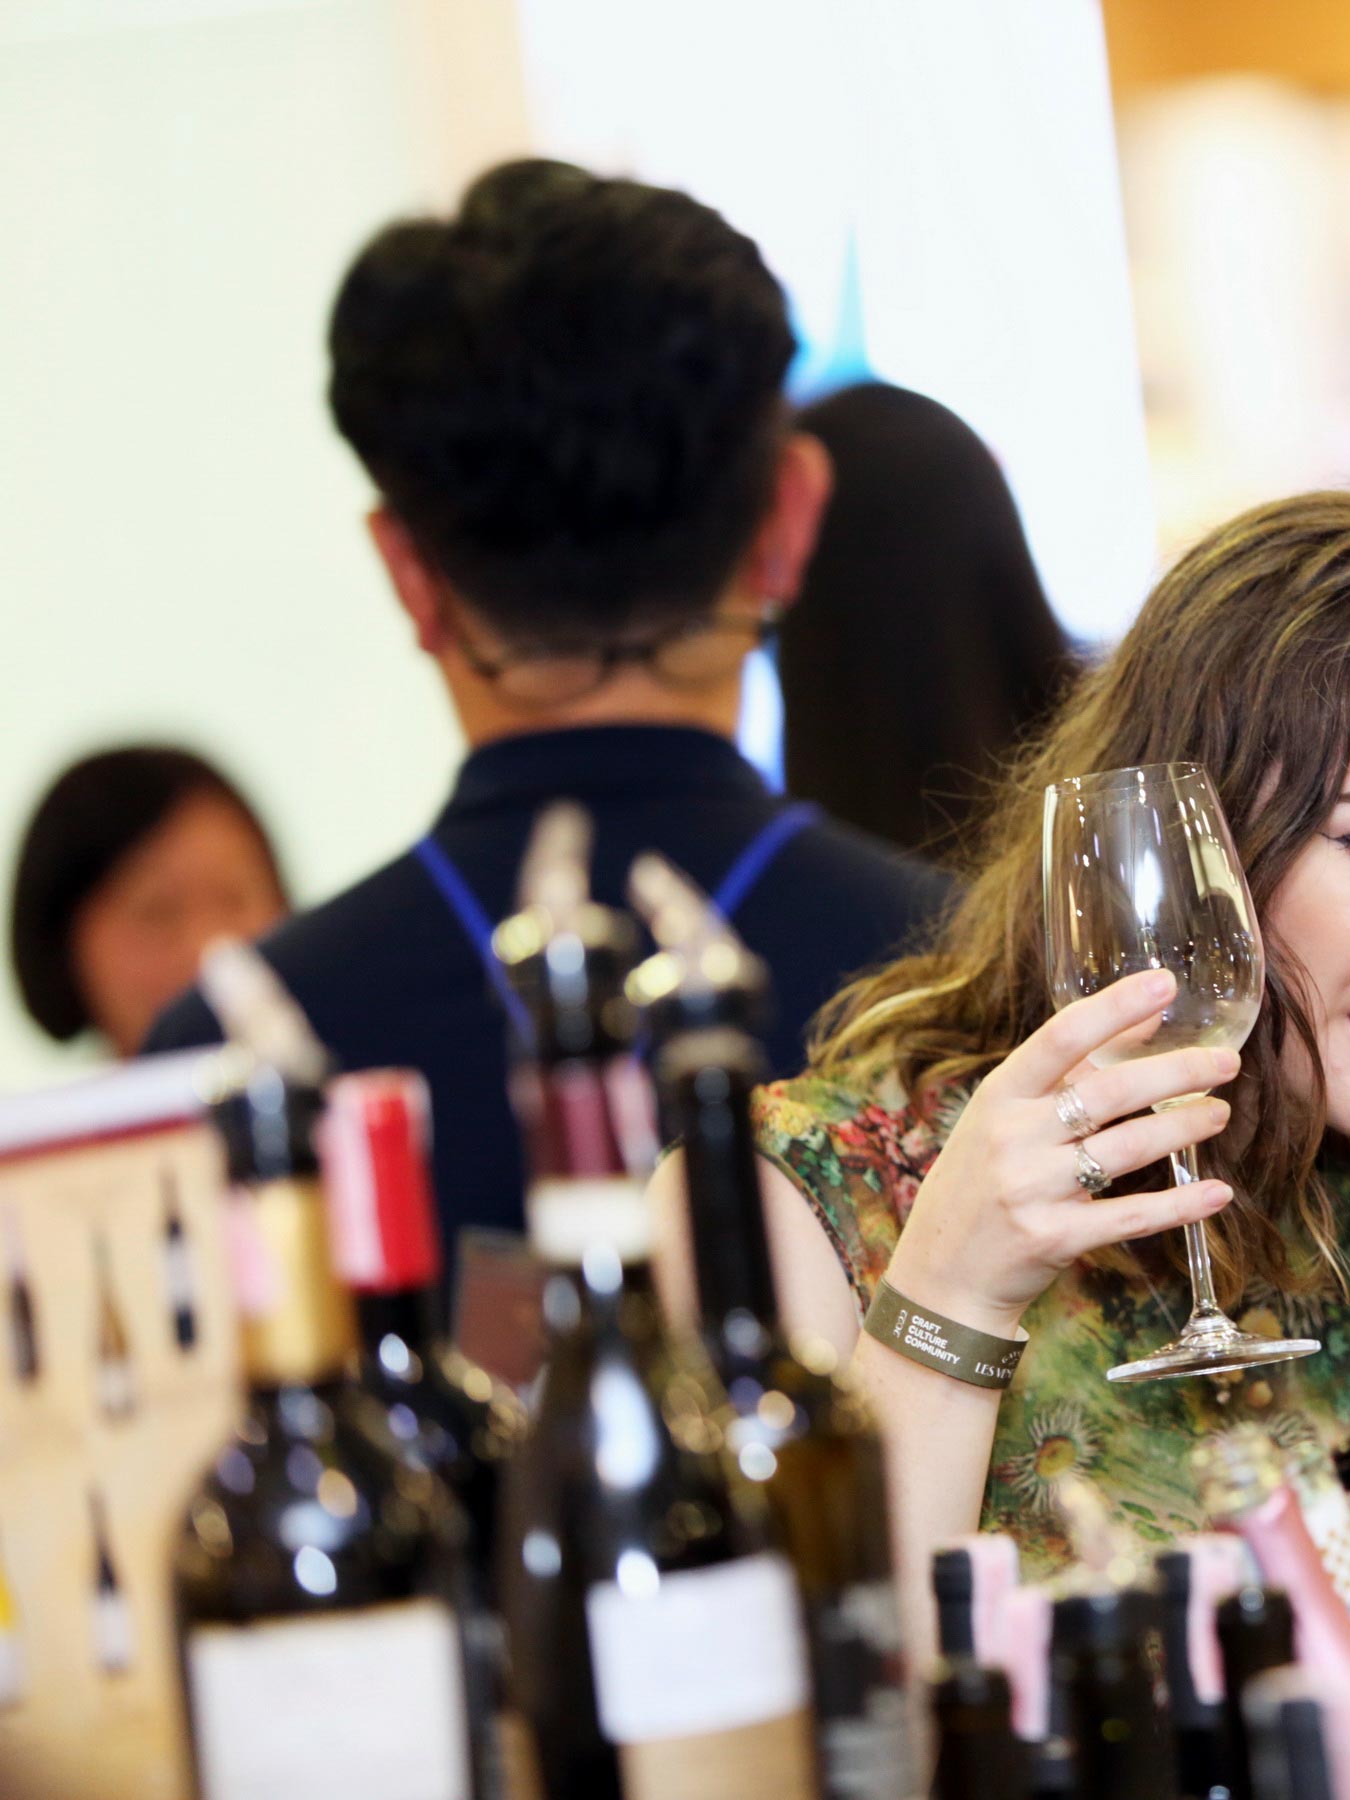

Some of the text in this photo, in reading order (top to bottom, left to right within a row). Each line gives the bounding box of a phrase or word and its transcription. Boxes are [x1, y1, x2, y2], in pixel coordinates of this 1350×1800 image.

[911, 1315, 942, 1335] CRAFT
[908, 1325, 948, 1349] CULTURE
[904, 1335, 960, 1364] COMMUNITY
[975, 1361, 995, 1377] LES
